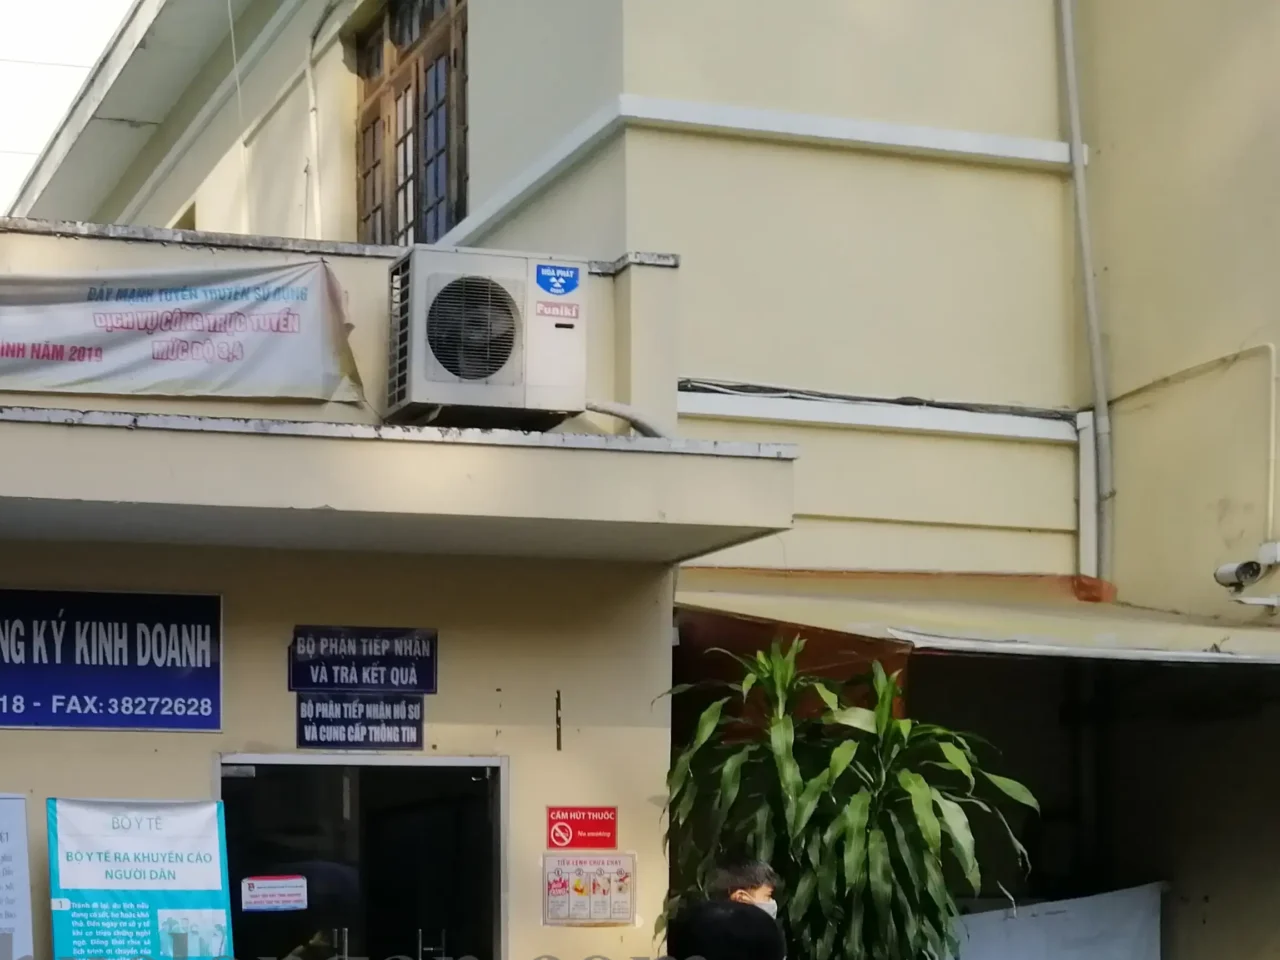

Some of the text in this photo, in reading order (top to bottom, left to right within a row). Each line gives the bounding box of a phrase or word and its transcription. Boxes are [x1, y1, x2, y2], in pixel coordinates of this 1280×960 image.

[93, 312, 134, 333] DỊCH
[160, 308, 204, 332] CÔNG
[250, 307, 301, 333] TUYẾN
[31, 341, 65, 361] NĂM
[68, 345, 103, 362] 2019
[32, 608, 67, 664] KÝ
[74, 620, 128, 667] KINH
[137, 623, 212, 668] DOANH
[296, 634, 431, 660] BỘ PHẬN TIẾP NHẬN
[310, 660, 418, 687] VÀ TRẢ KẾT QUẢ
[300, 699, 314, 721] BỘ
[315, 700, 341, 722] PHẬN
[342, 698, 364, 719] TIẾP
[304, 721, 417, 743] VÀ CUNG CẤP THÔNG TIN
[134, 817, 143, 830] Y
[550, 810, 615, 820] CẤM HÚT THUỐC
[86, 852, 94, 863] Y
[114, 852, 131, 863] RA
[105, 867, 176, 881] NGƯỜI DÂN
